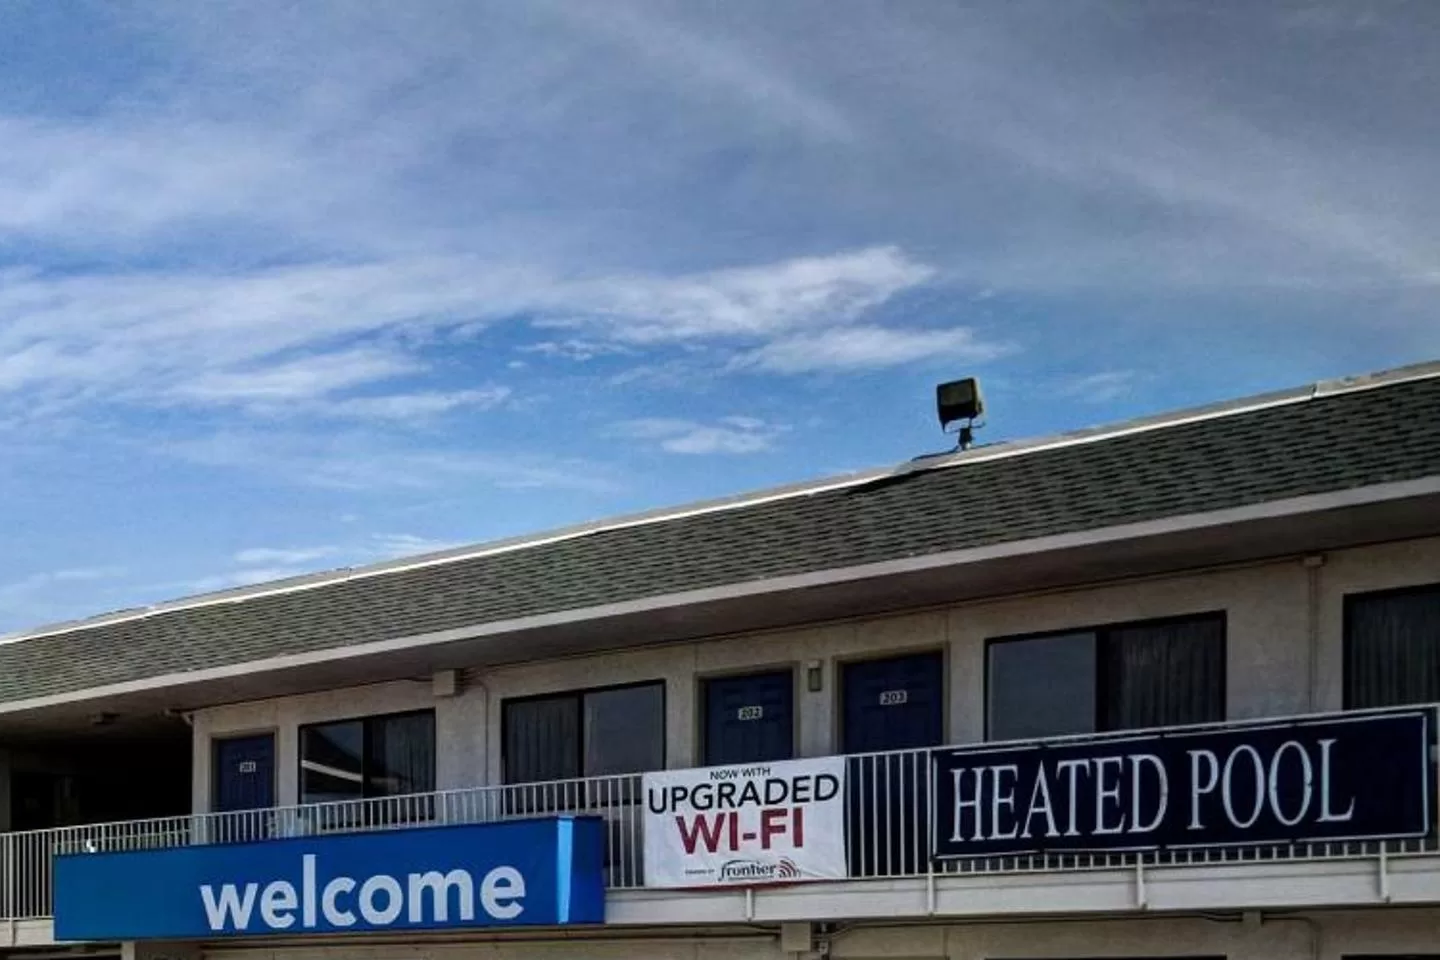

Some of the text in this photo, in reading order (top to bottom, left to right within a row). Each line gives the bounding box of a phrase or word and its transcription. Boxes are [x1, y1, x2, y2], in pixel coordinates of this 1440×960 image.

[648, 773, 840, 814] UPGRADED
[710, 767, 771, 780] NOW WITH
[948, 737, 1356, 843] HEATED POOL
[675, 807, 803, 855] WI-FI
[718, 859, 777, 881] frontier
[199, 854, 526, 931] welcome
